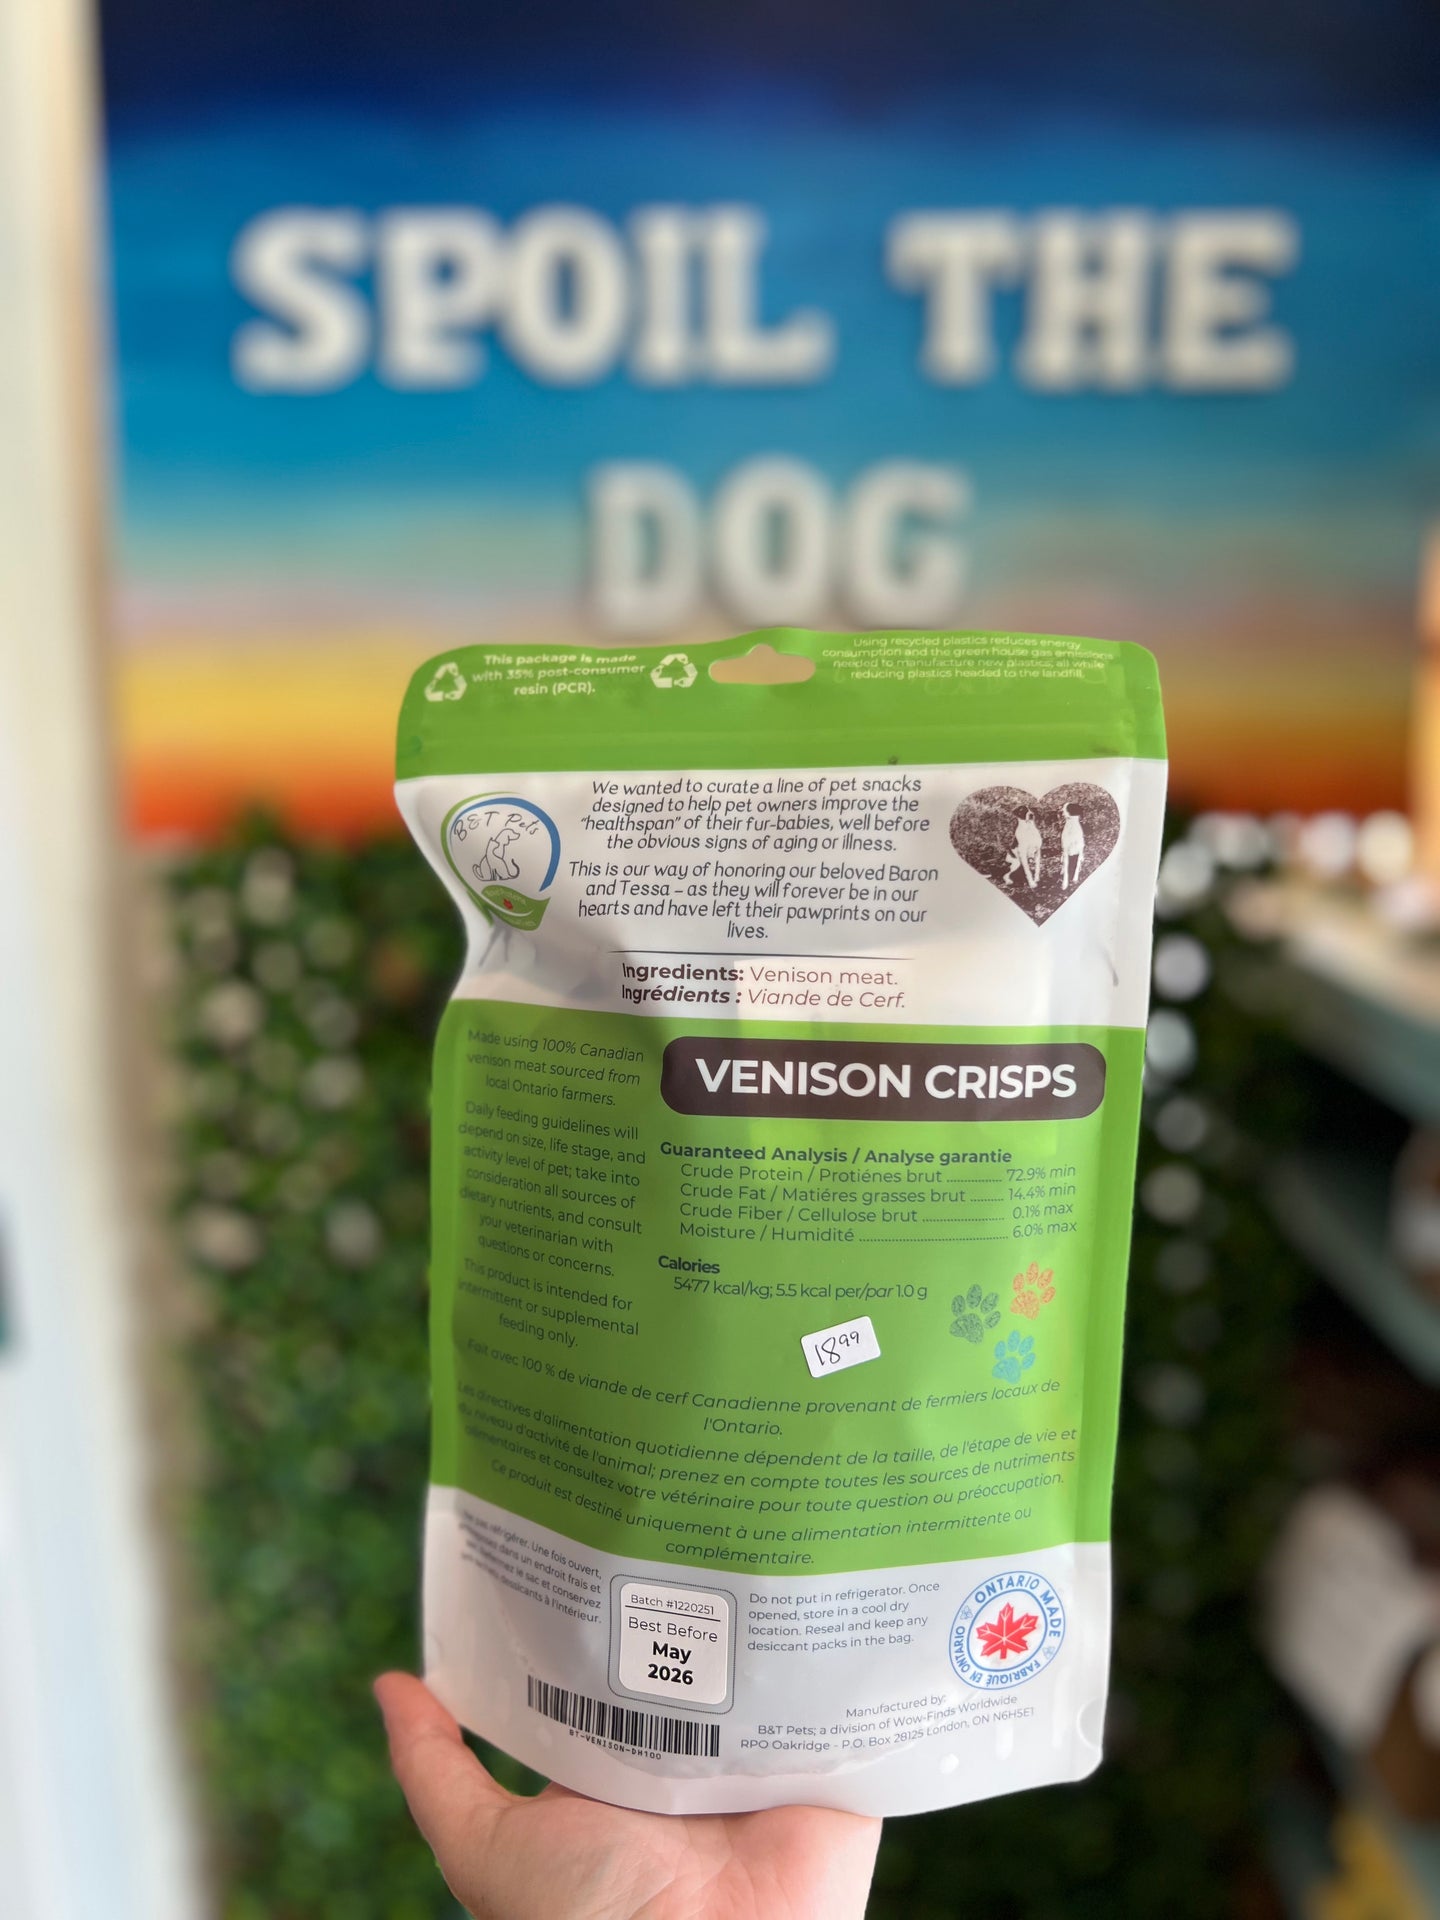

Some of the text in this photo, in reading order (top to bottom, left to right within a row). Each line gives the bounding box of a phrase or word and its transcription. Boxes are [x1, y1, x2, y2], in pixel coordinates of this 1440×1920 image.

[227, 202, 1297, 394] SPOIL THE
[583, 454, 970, 632] DOG
[484, 653, 637, 667] This package is made
[473, 665, 645, 682] with 35% post-consumer
[514, 682, 595, 695] resin (PCR).
[592, 775, 922, 796] We wanted to curate a line of pet snacks
[592, 796, 920, 816] designed to help pet owners improve the
[581, 814, 930, 833] “healthspan” of their fur-babies, well before
[607, 833, 897, 853] the obvious signs of aging or illness.
[622, 964, 899, 986] Ingredients: Venison meat.
[622, 985, 729, 1004] Ingrédients
[748, 988, 820, 1008] Viande
[826, 990, 853, 1008] de
[860, 991, 906, 1009] Cerf.
[468, 1029, 644, 1062] Made using 100% Canadian
[486, 1074, 616, 1106] local Ontario farmers.
[695, 1058, 1077, 1100] VENISON CRISPS
[660, 1141, 766, 1161] Guaranteed
[771, 1147, 848, 1164] Analysis
[864, 1149, 935, 1165] Analyse
[940, 1149, 1012, 1166] garantie
[680, 1164, 734, 1180] Crude
[739, 1166, 803, 1182] Protein
[907, 1168, 942, 1184] brut
[1007, 1168, 1046, 1182] 72.9%
[1050, 1164, 1076, 1178] min
[680, 1183, 734, 1200] Crude
[738, 1185, 766, 1201] Fat
[862, 1190, 925, 1207] grasses
[930, 1188, 966, 1203] brut
[1008, 1185, 1045, 1200] 14.4%
[1050, 1183, 1076, 1197] min
[680, 1203, 733, 1219] Crude
[738, 1204, 782, 1221] Fiber
[799, 1206, 876, 1223] Cellulose
[881, 1207, 917, 1223] brut
[1012, 1205, 1040, 1220] 0.1%
[1043, 1203, 1073, 1216] max
[680, 1222, 755, 1239] Moisture
[772, 1225, 855, 1243] Humidité
[1012, 1223, 1043, 1239] 6.0%
[1047, 1221, 1077, 1234] max
[478, 1235, 614, 1277] questions or concerns.
[658, 1255, 720, 1275] Calories
[673, 1277, 927, 1300] 5477 kcal/kg; 5.5 kcal per/par 1.0 g
[703, 1417, 783, 1436] l'Ontario.
[491, 1460, 1032, 1541] Ce produit est destiné uniquement à une alimentation intermittente ou
[665, 1541, 814, 1565] complémentaire.
[631, 1594, 714, 1615] Batch #1220251
[750, 1581, 940, 1606] Do not put in refrigerator. Once
[974, 1575, 1061, 1638] ONTARIO MADE
[628, 1616, 718, 1642] Best Before
[652, 1641, 691, 1664] May
[648, 1663, 694, 1685] 2026
[758, 1694, 1017, 1736] B&T Pets; a division of Wow-Finds Worldwide
